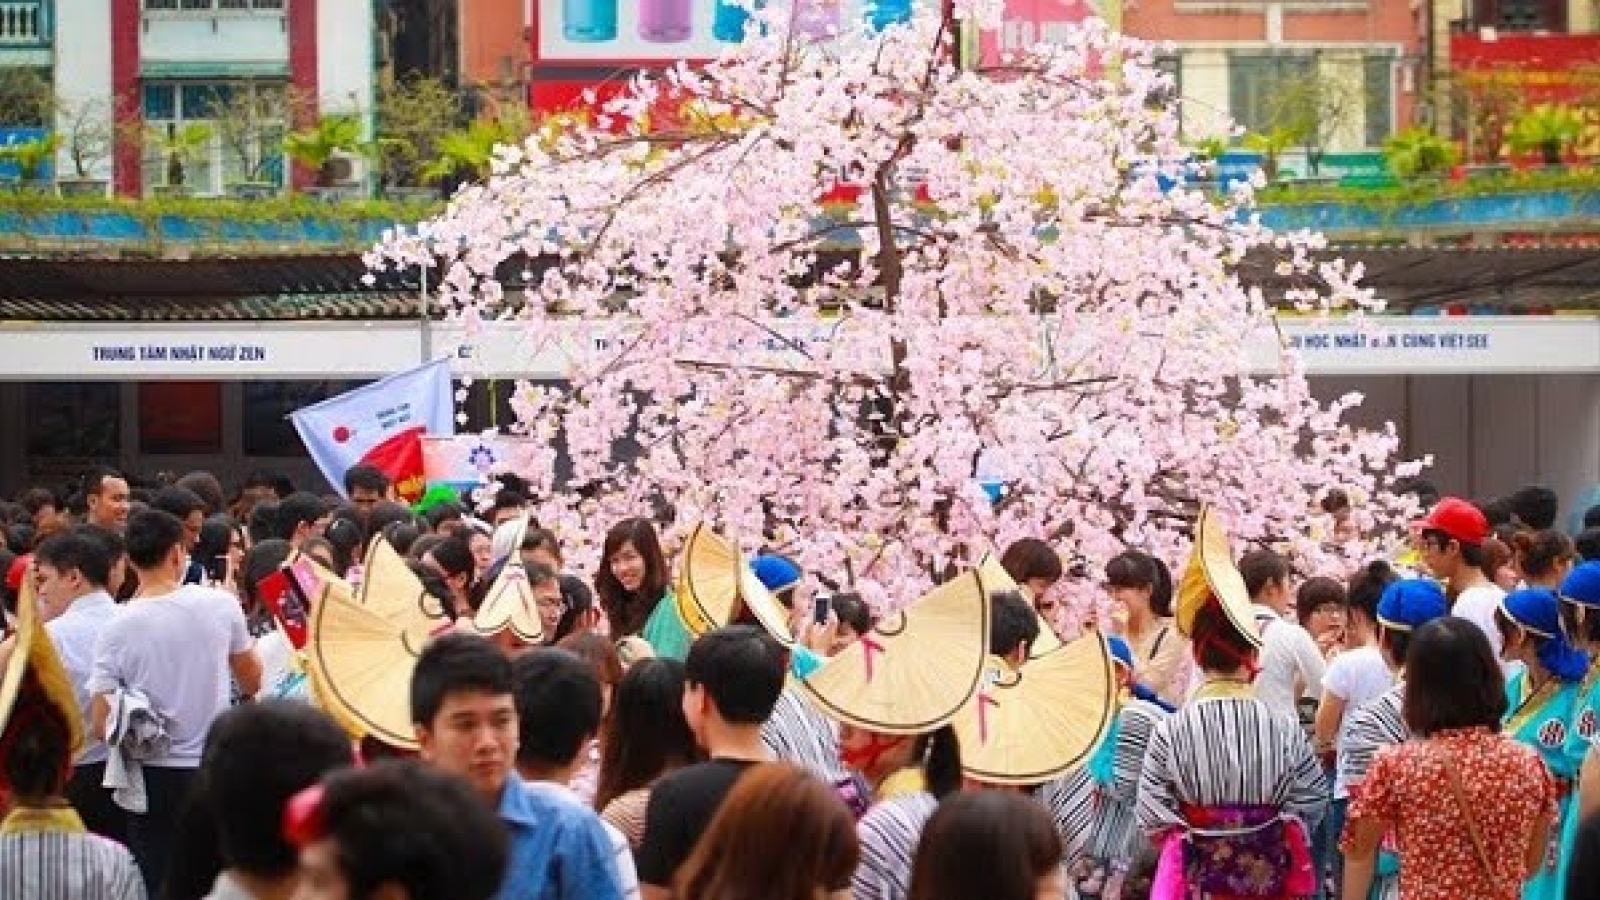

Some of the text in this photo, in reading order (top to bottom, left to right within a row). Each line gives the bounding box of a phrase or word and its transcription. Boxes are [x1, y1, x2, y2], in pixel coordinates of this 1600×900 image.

[93, 346, 136, 361] TRUNG
[170, 345, 205, 363] NHẬT
[239, 346, 266, 361] ZEN
